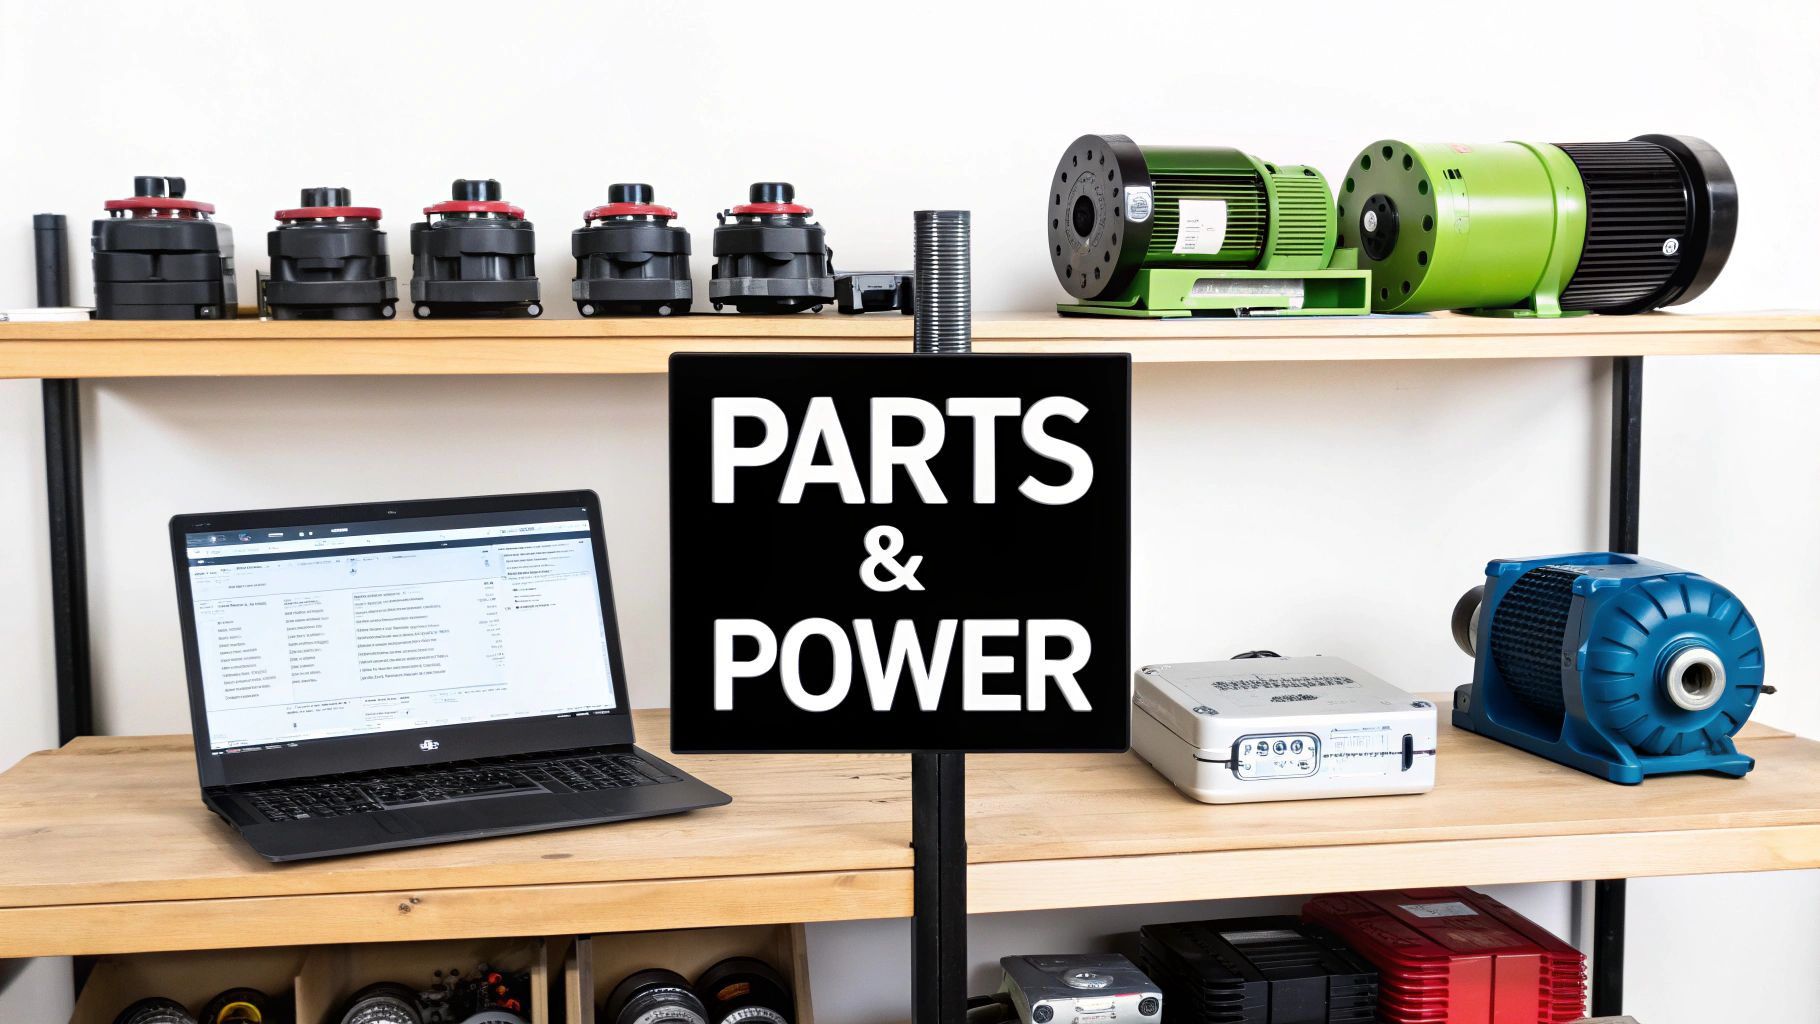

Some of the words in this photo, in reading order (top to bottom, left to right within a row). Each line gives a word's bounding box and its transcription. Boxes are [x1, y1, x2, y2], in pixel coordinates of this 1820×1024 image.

[711, 396, 1095, 505] PARTS
[858, 524, 926, 592] &
[713, 617, 1094, 712] POWER
